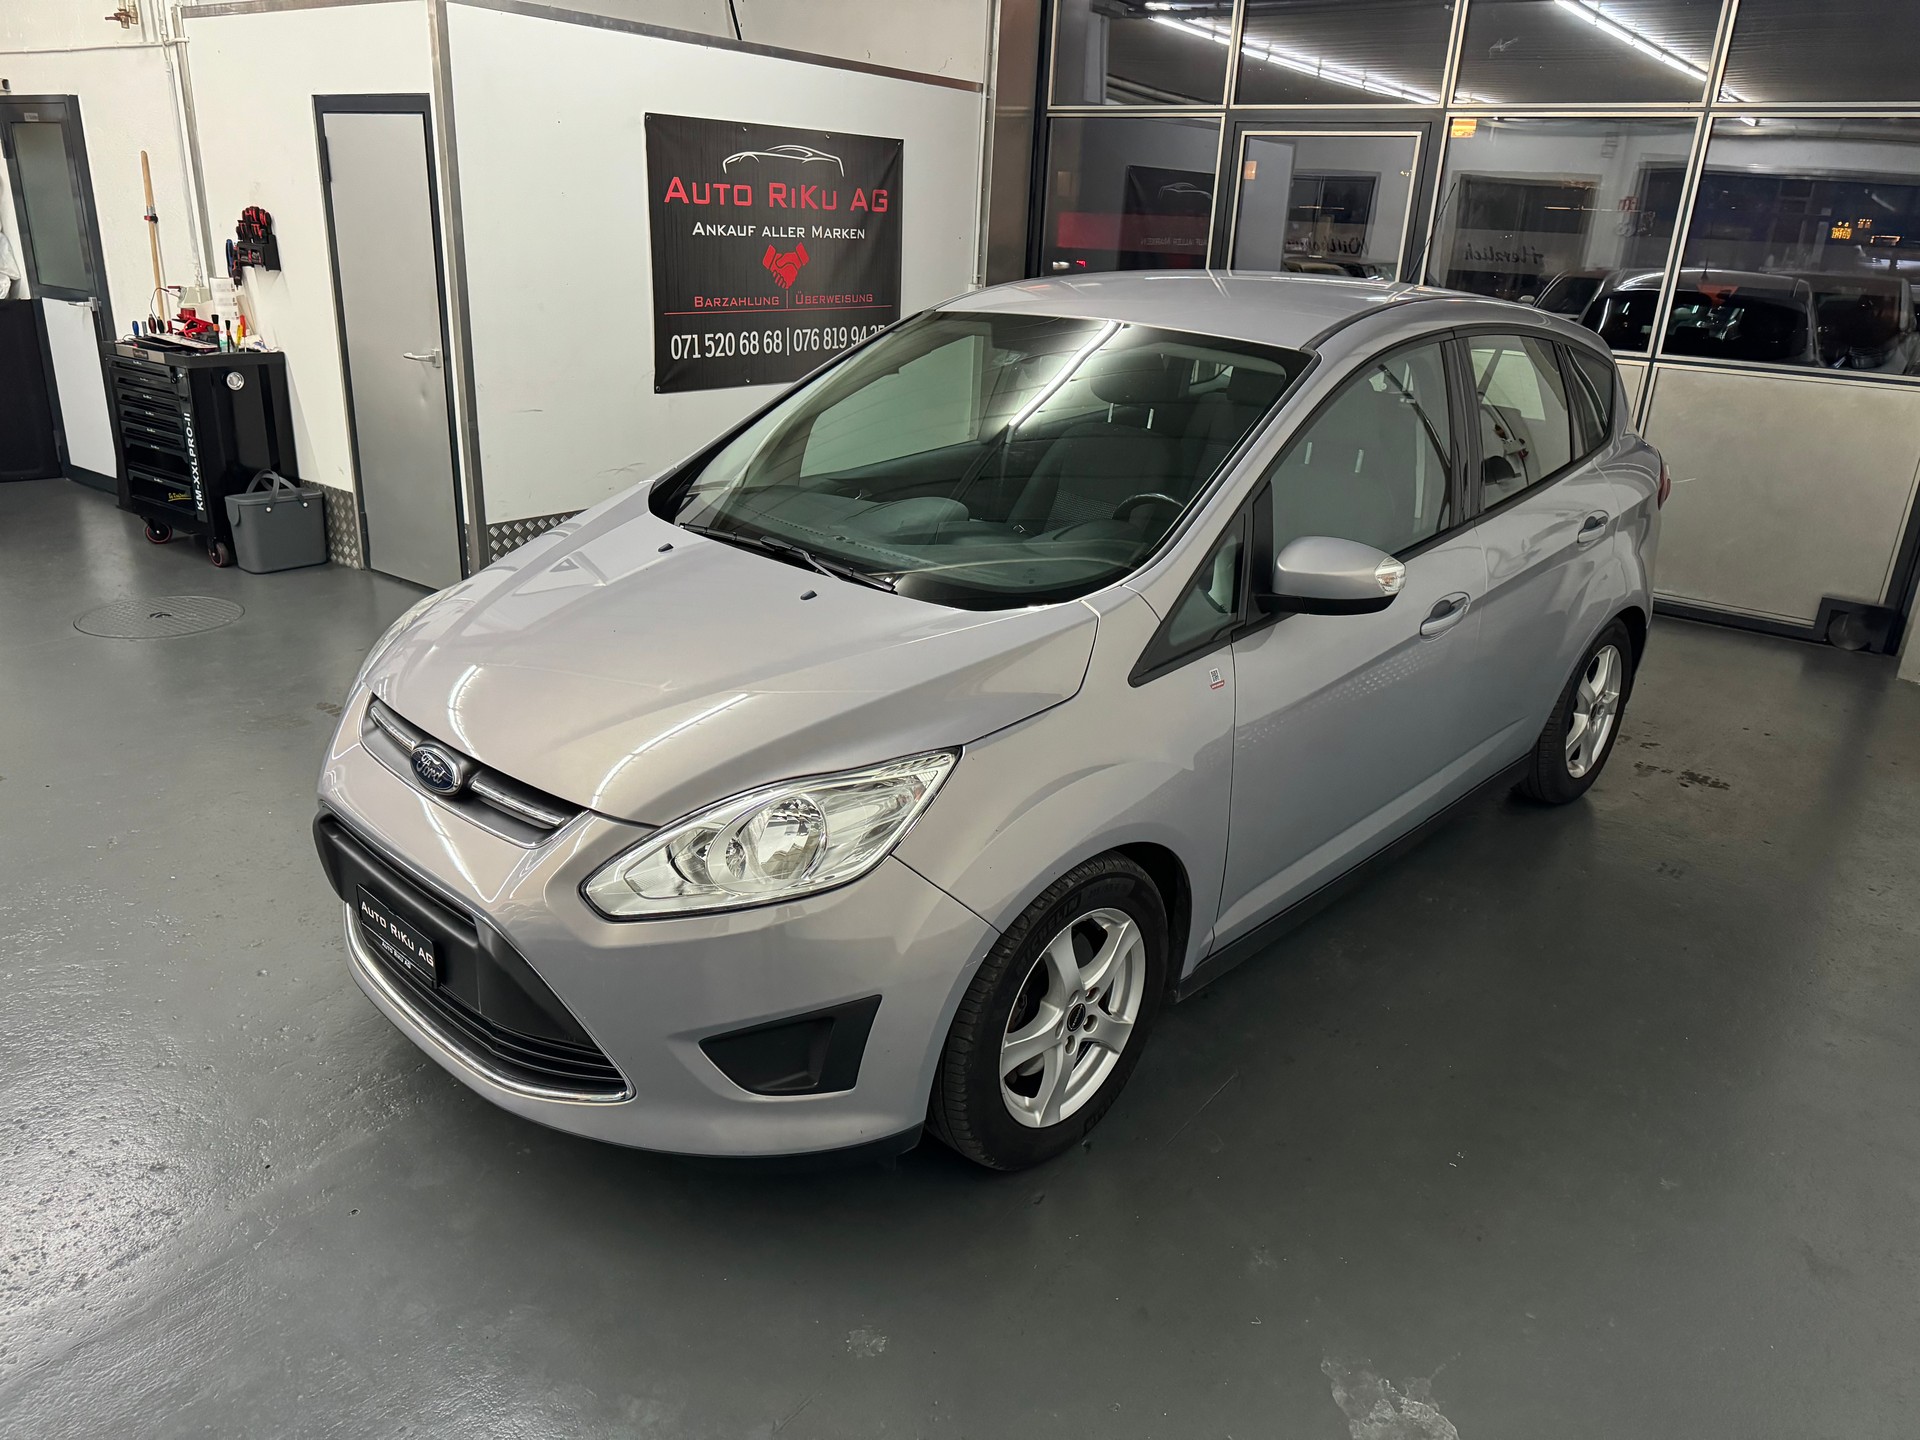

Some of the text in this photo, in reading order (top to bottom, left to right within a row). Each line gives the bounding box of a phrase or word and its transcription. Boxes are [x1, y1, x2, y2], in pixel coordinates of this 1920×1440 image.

[850, 188, 888, 213] AG
[692, 222, 865, 240] ANKAUF ALLER MARKEN
[694, 290, 873, 308] BARZAHLUNG ÜBERWEISUNG
[670, 334, 701, 360] 071
[704, 332, 736, 358] 520
[739, 330, 760, 356] 68
[763, 329, 783, 355] 68
[793, 327, 820, 352] 076
[822, 325, 848, 350] 819
[416, 753, 446, 784] Ford
[418, 947, 435, 968] AG
